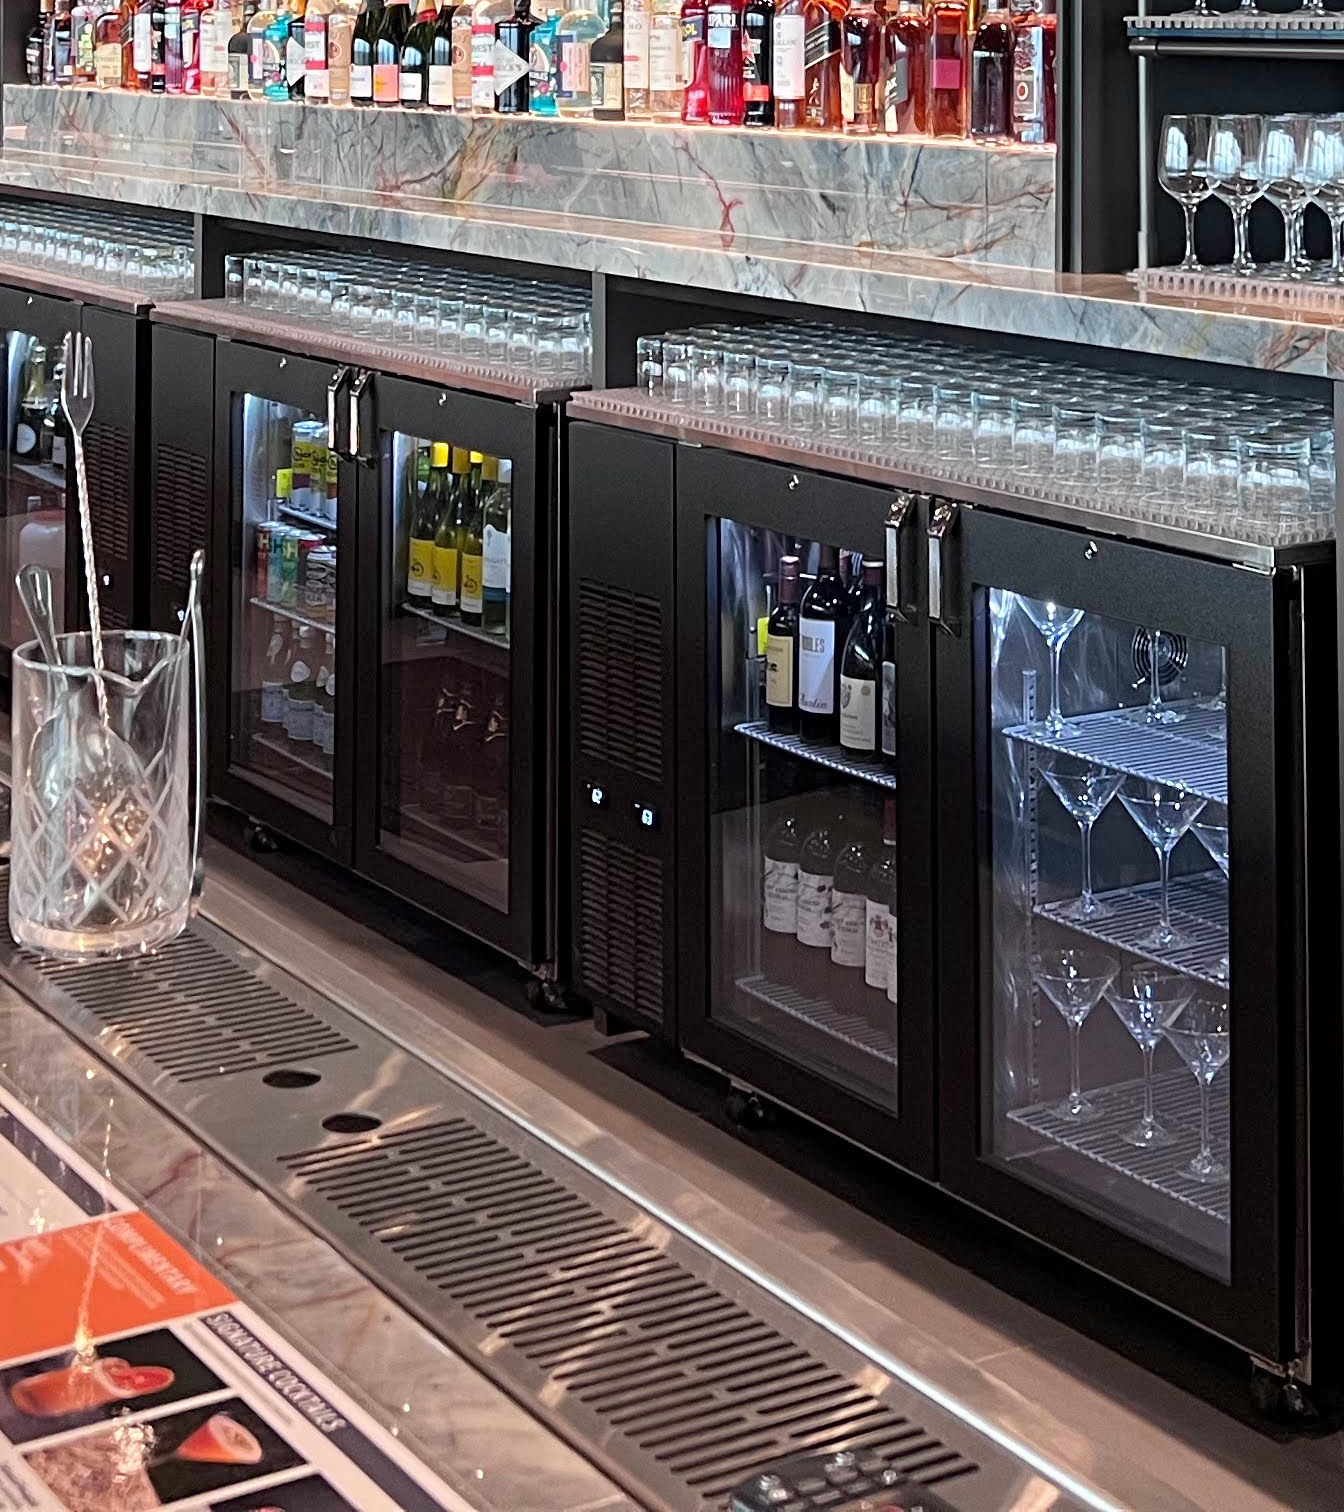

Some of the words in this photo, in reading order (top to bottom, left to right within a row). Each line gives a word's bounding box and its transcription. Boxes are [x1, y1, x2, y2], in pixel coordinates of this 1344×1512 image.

[708, 12, 738, 28] PARI
[206, 1313, 283, 1375] SIGNATURE
[269, 1370, 348, 1433] COCKTAILS
